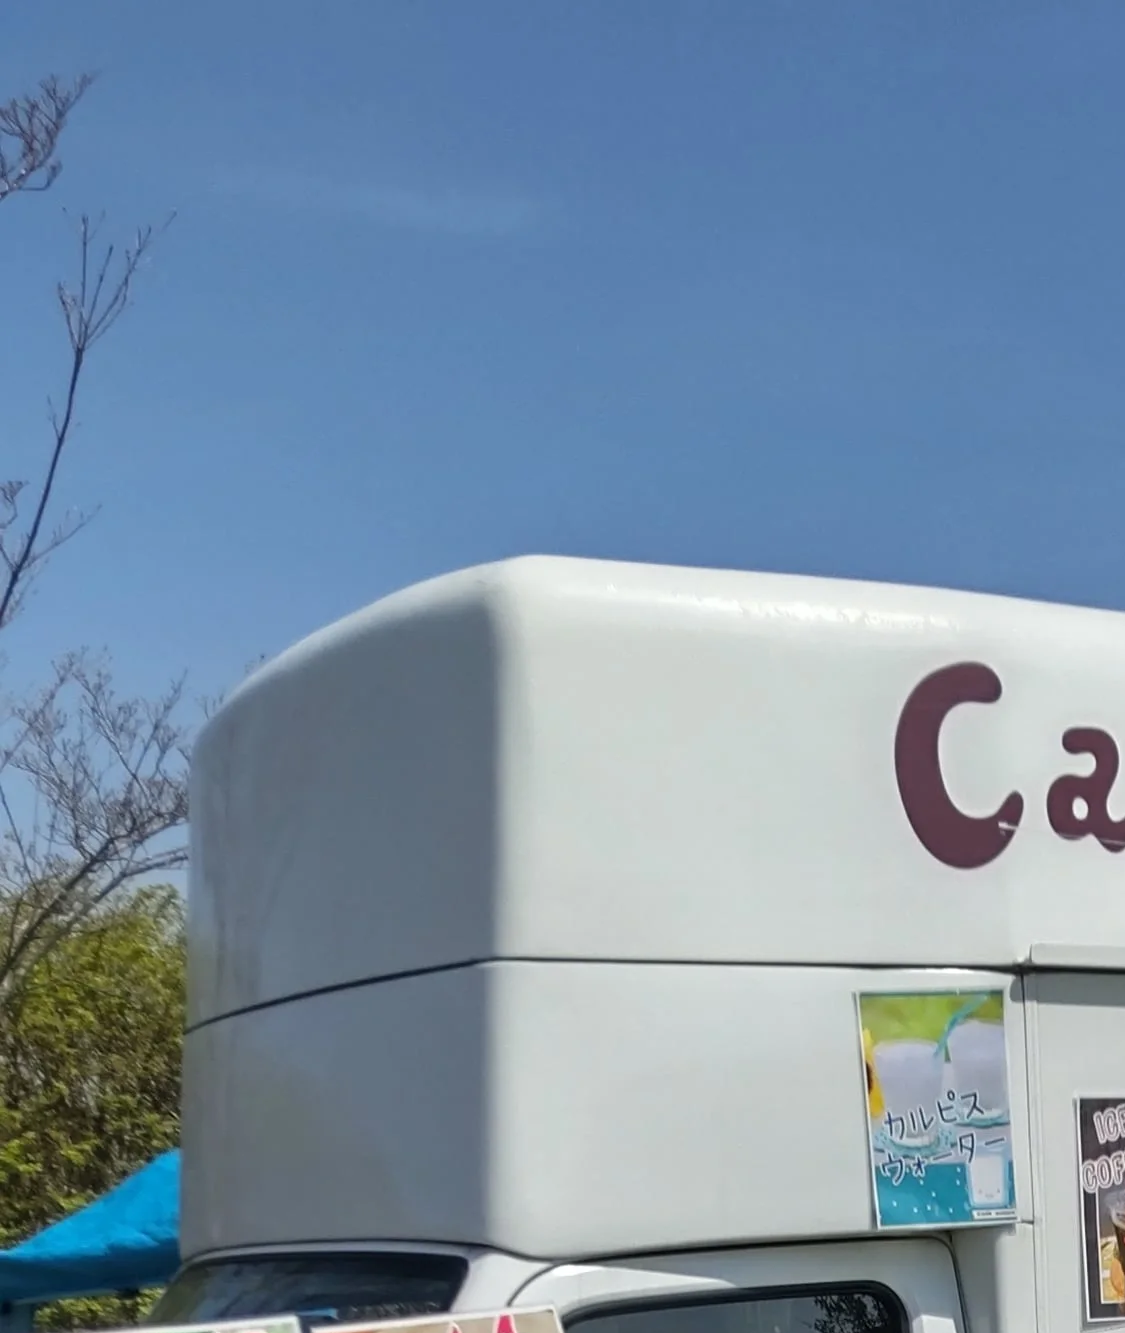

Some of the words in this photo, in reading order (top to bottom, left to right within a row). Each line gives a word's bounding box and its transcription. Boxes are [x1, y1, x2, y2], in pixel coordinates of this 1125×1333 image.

[884, 1090, 984, 1140] カルピス
[881, 1132, 1005, 1184] ウォーター
